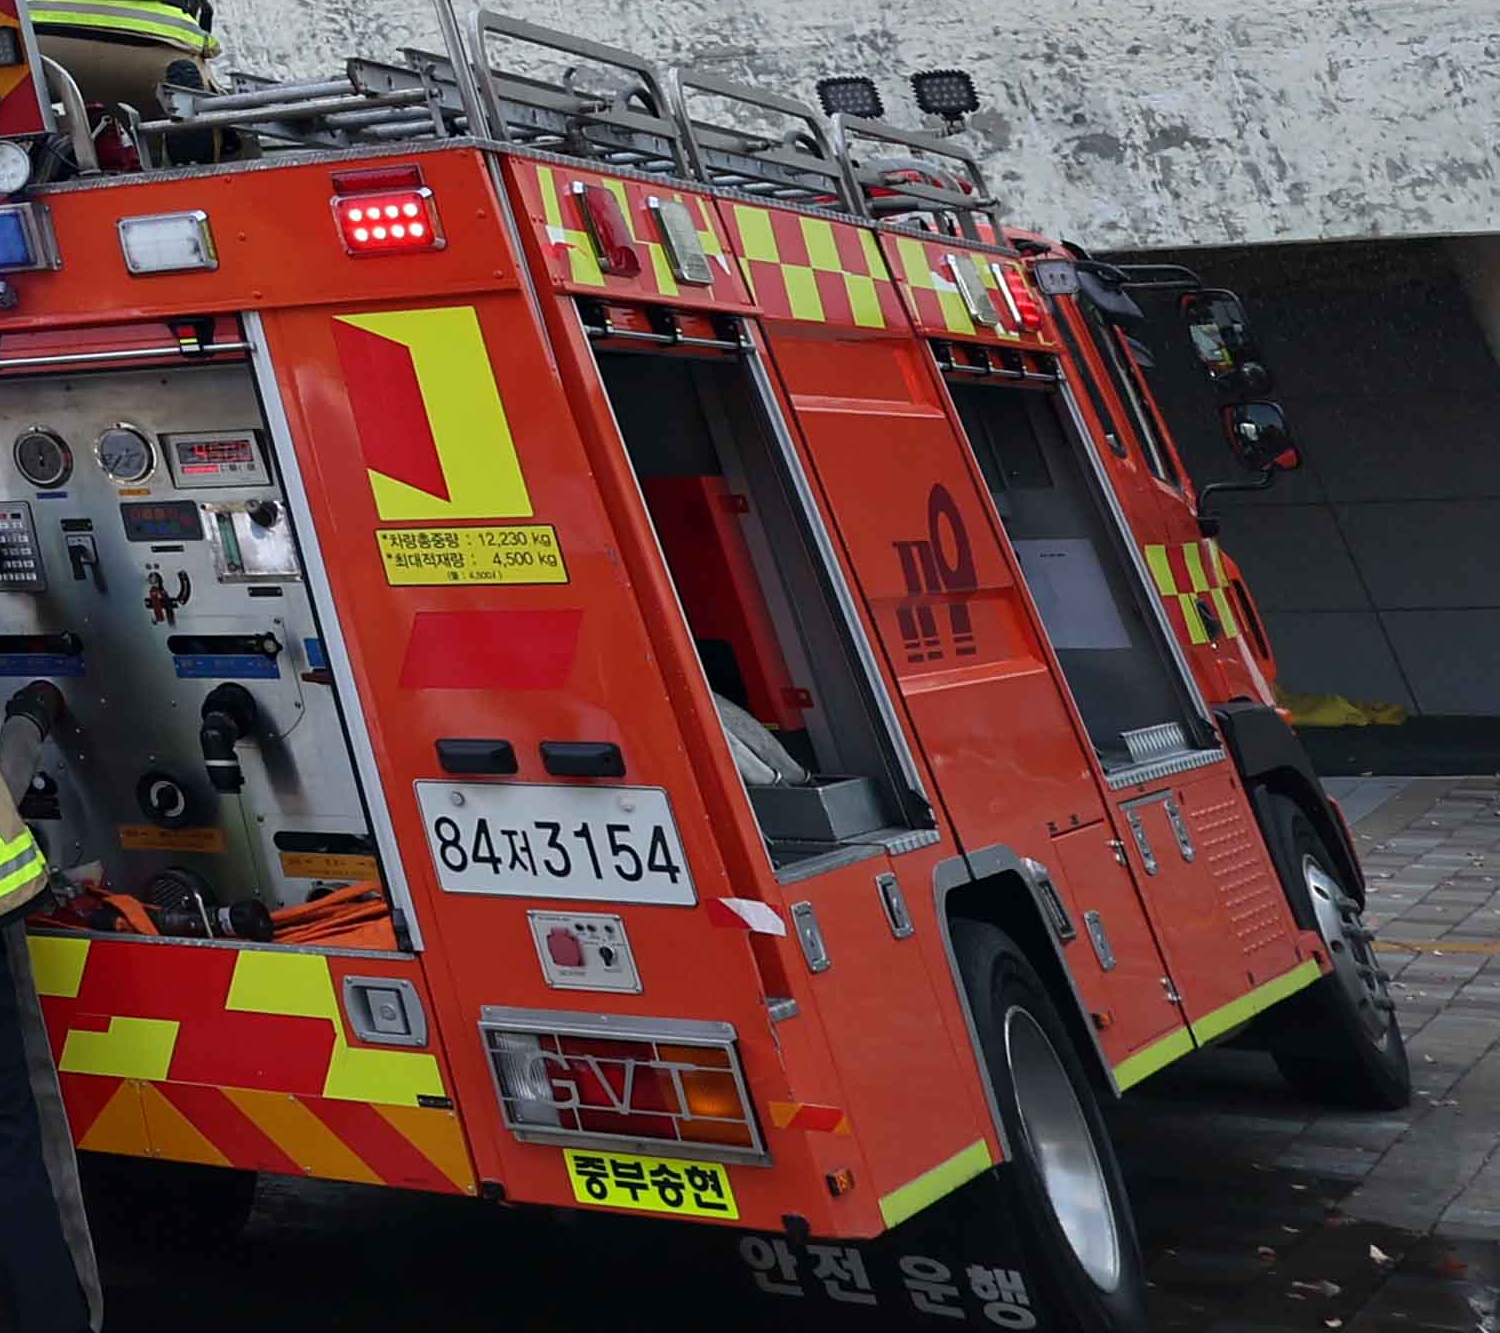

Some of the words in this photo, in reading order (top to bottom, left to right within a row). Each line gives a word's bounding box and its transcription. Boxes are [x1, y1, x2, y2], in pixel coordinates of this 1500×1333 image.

[478, 531, 528, 548] 12,230
[532, 531, 552, 548] kg
[492, 551, 534, 568] 4,500
[538, 552, 558, 567] kg
[434, 815, 682, 885] 84저3154
[572, 1155, 727, 1214] 중부송현
[739, 1235, 878, 1306] 안전
[899, 1255, 1038, 1331] 운행
